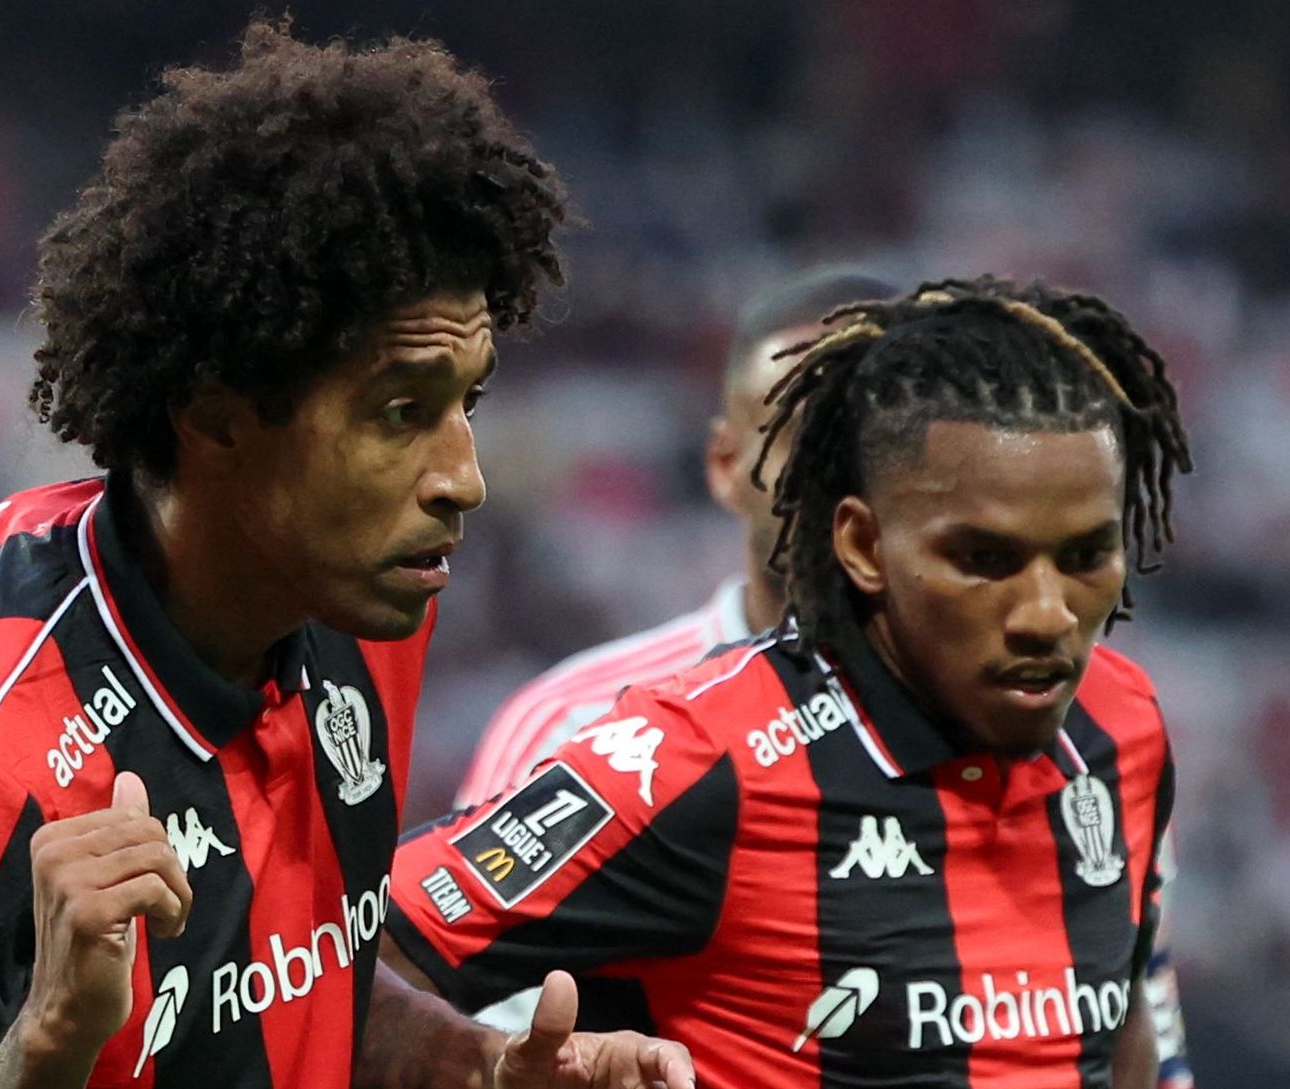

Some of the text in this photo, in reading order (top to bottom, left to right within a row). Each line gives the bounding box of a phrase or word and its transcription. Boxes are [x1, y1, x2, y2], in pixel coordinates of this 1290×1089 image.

[47, 664, 137, 788] actual
[330, 709, 352, 732] OGC
[333, 722, 357, 745] NICE
[491, 811, 545, 865] LIGUE
[421, 867, 471, 924] 1TEAM
[212, 874, 390, 1034] Robnhoo
[906, 967, 1130, 1049] Robinho
